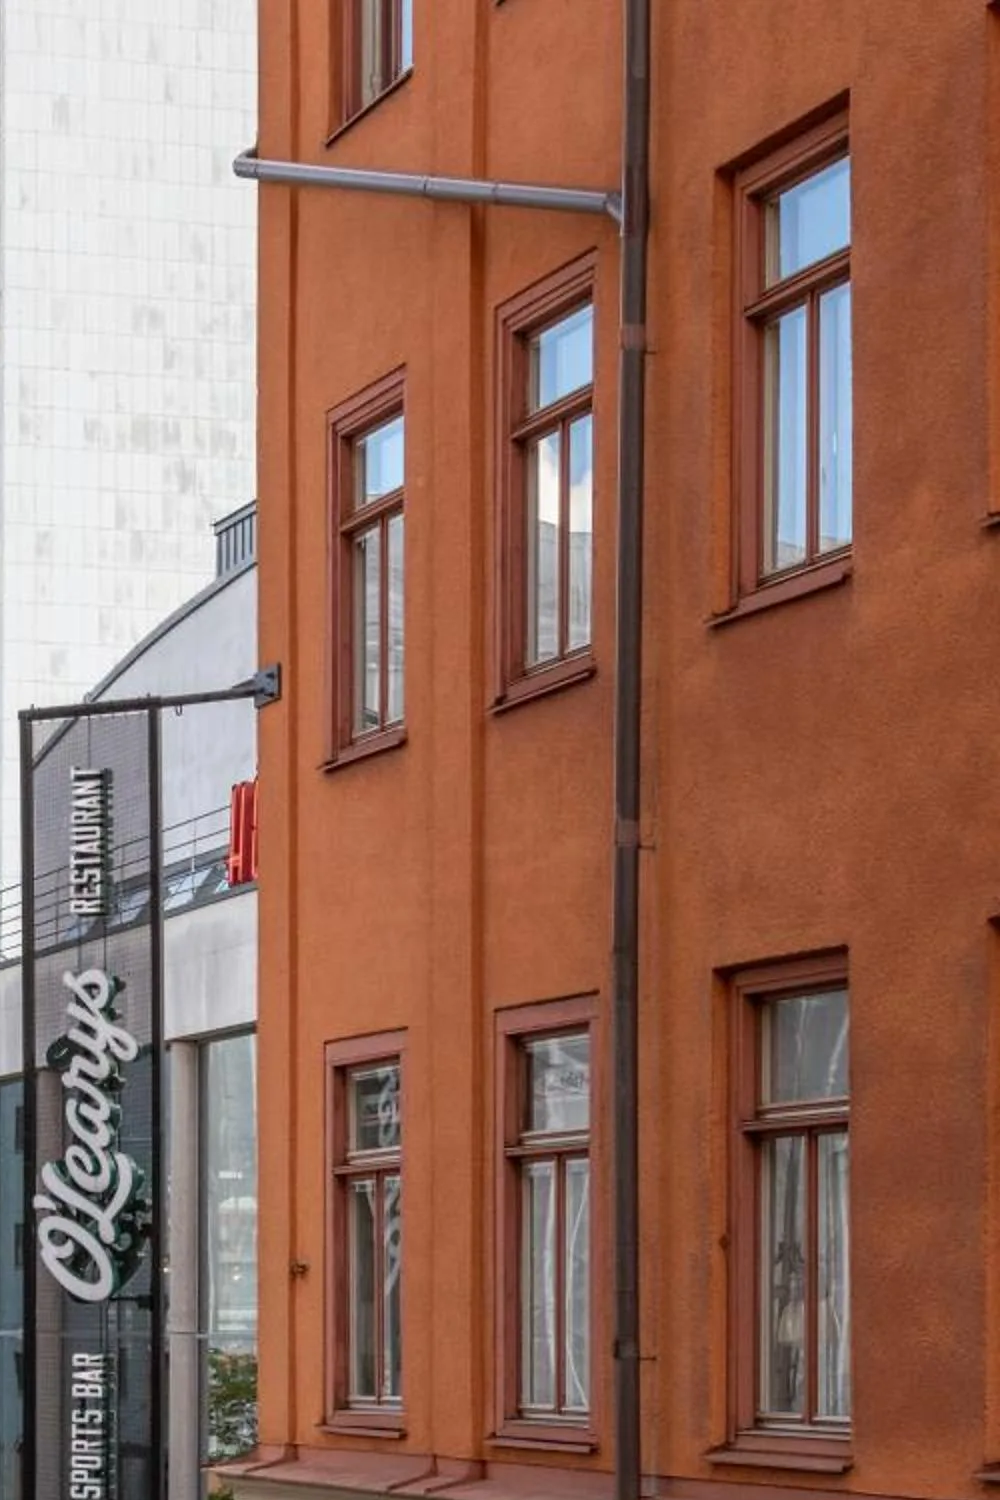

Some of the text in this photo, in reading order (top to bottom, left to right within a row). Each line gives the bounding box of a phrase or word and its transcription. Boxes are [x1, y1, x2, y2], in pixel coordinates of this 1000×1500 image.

[70, 766, 104, 916] RESTAURANT
[33, 969, 138, 1301] O'Learys
[70, 1353, 105, 1499] SPORTS BAR
